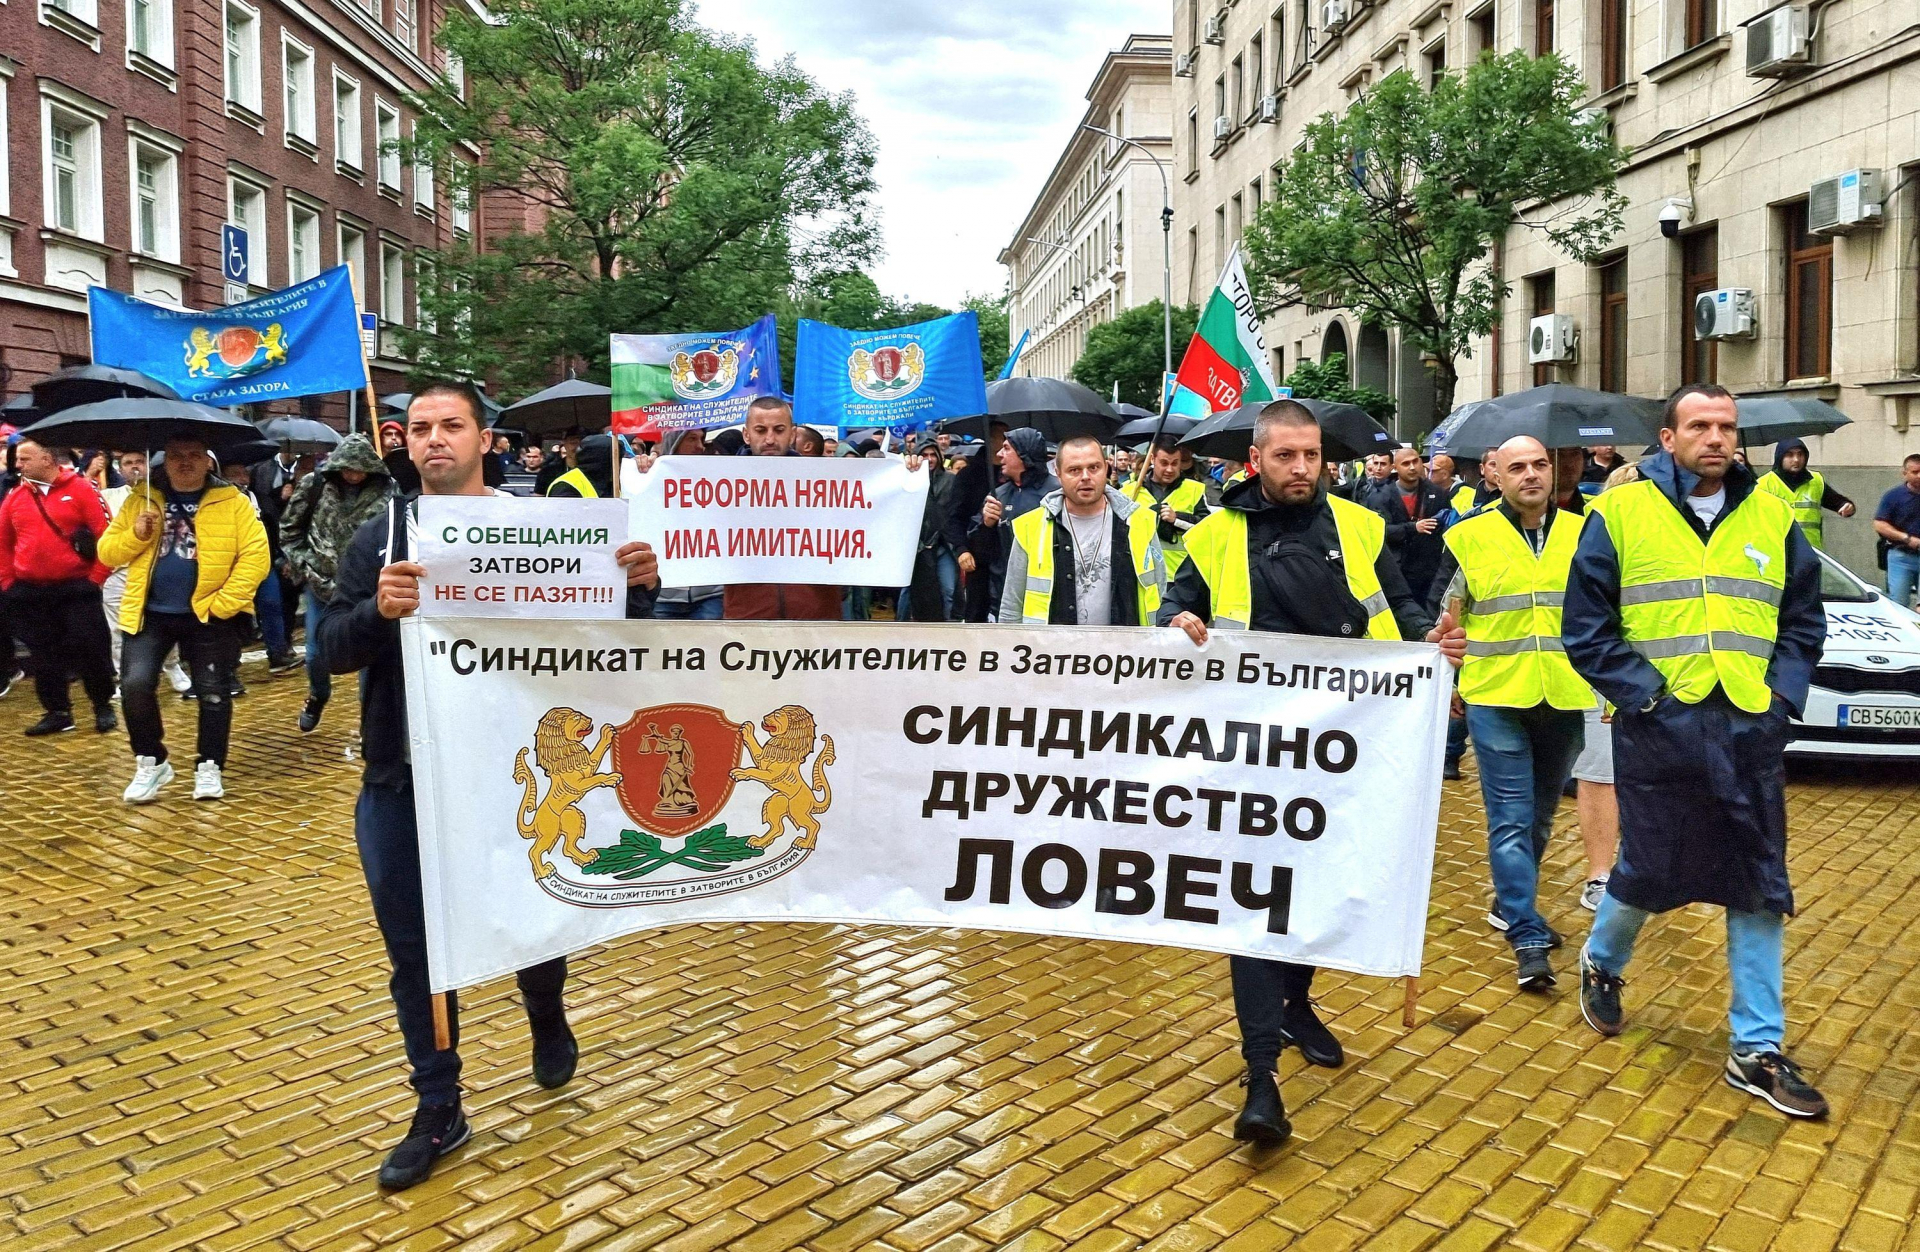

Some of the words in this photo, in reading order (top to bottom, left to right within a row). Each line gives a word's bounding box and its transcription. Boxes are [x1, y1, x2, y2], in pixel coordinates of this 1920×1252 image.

[849, 337, 874, 347] ЗАЕДНО
[874, 333, 897, 341] МОЖЕМ
[192, 386, 235, 402] СТАРА
[239, 381, 290, 395] ЗАГОРА
[642, 404, 688, 413] СИНДИКАТ
[703, 393, 758, 409] СЛУЖИТЕЛИТЕ
[654, 411, 703, 420] ЗАТВОРИТЕ
[712, 404, 750, 416] БЪЛГАРИ
[889, 396, 935, 408] СЛУЖИТЕЛИТЕ
[898, 402, 933, 412] БЪЛГАРИЯ
[657, 420, 685, 428] АРЕСТ
[698, 413, 743, 424] КЪРДЖАЛИ
[877, 412, 914, 421] КЪРДЖАЛИ
[664, 477, 788, 509] РЕФОРМА
[795, 479, 873, 509] НЯМА.
[442, 526, 458, 544] С
[466, 526, 609, 547] ОБЕЩАНИЯ
[664, 528, 721, 559] ИМА
[728, 528, 872, 564] ИМИТАЦИЯ.
[469, 557, 581, 574] ЗАТВОРИ
[434, 585, 466, 600] НЕ
[474, 586, 506, 602] СЕ
[514, 586, 613, 603] ПАЗЯТ!!!
[430, 638, 650, 676] "Синдикат
[661, 648, 706, 671] на
[719, 641, 968, 680] Служителите
[979, 650, 1000, 672] в
[1010, 644, 1195, 684] Затворите
[1205, 658, 1225, 681] в
[1236, 652, 1433, 702] България"
[1851, 708, 1871, 724] CB
[1874, 709, 1911, 726] 5600
[902, 705, 1359, 774] СИНДИКАЛНО
[921, 769, 1328, 841] ДРУЖЕСТВО
[549, 879, 594, 901] СИНДИКАТ
[597, 892, 608, 901] НА
[610, 887, 677, 901] СЛУЖИТЕЛИТЕ
[680, 886, 687, 895] В
[690, 876, 745, 893] ЗАТВОРИТЕ
[748, 873, 754, 881] В
[756, 851, 800, 879] БЪЛГАРИЯ
[944, 837, 1294, 936] ЛОВЕЧ
